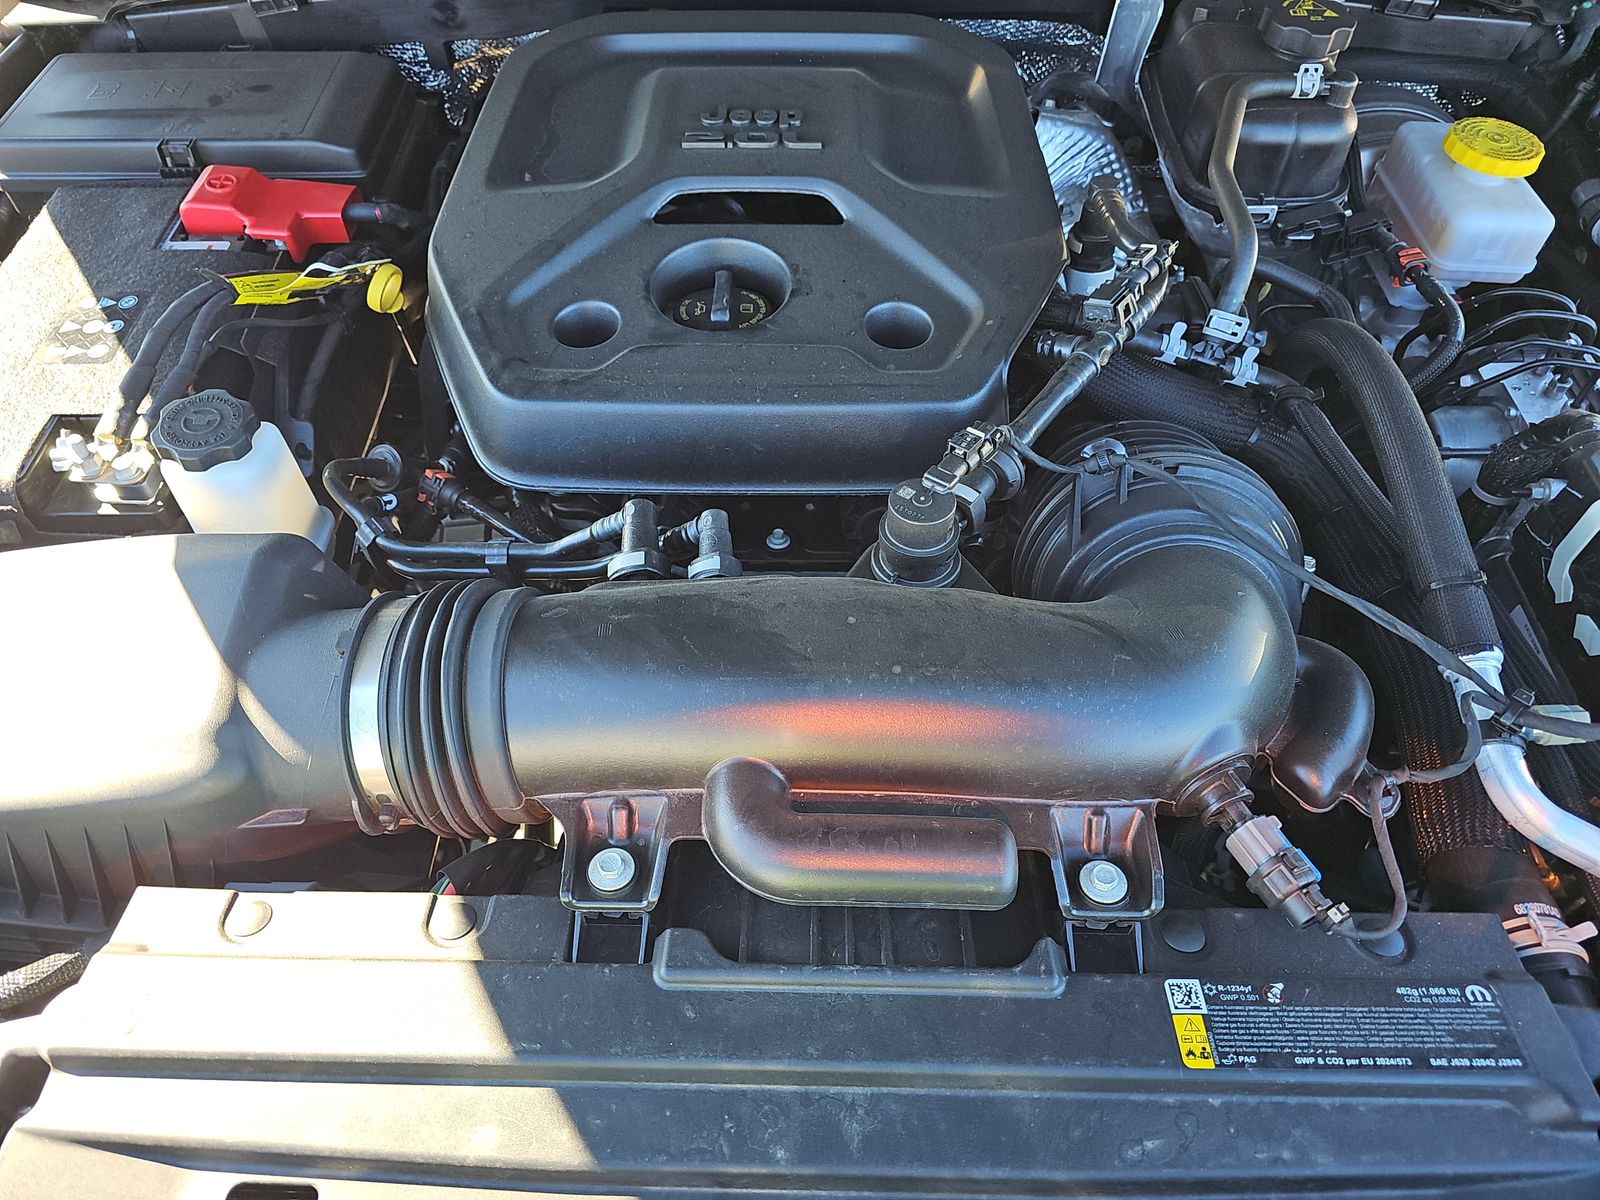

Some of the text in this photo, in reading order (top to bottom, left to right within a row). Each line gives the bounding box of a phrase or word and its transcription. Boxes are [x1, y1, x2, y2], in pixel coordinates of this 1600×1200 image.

[700, 104, 803, 129] Jeep
[681, 131, 822, 149] 2.0L
[1219, 993, 1239, 1001] GWP
[1294, 1056, 1315, 1065] GWP
[1325, 1057, 1344, 1065] CO2
[1361, 1057, 1374, 1065] EU
